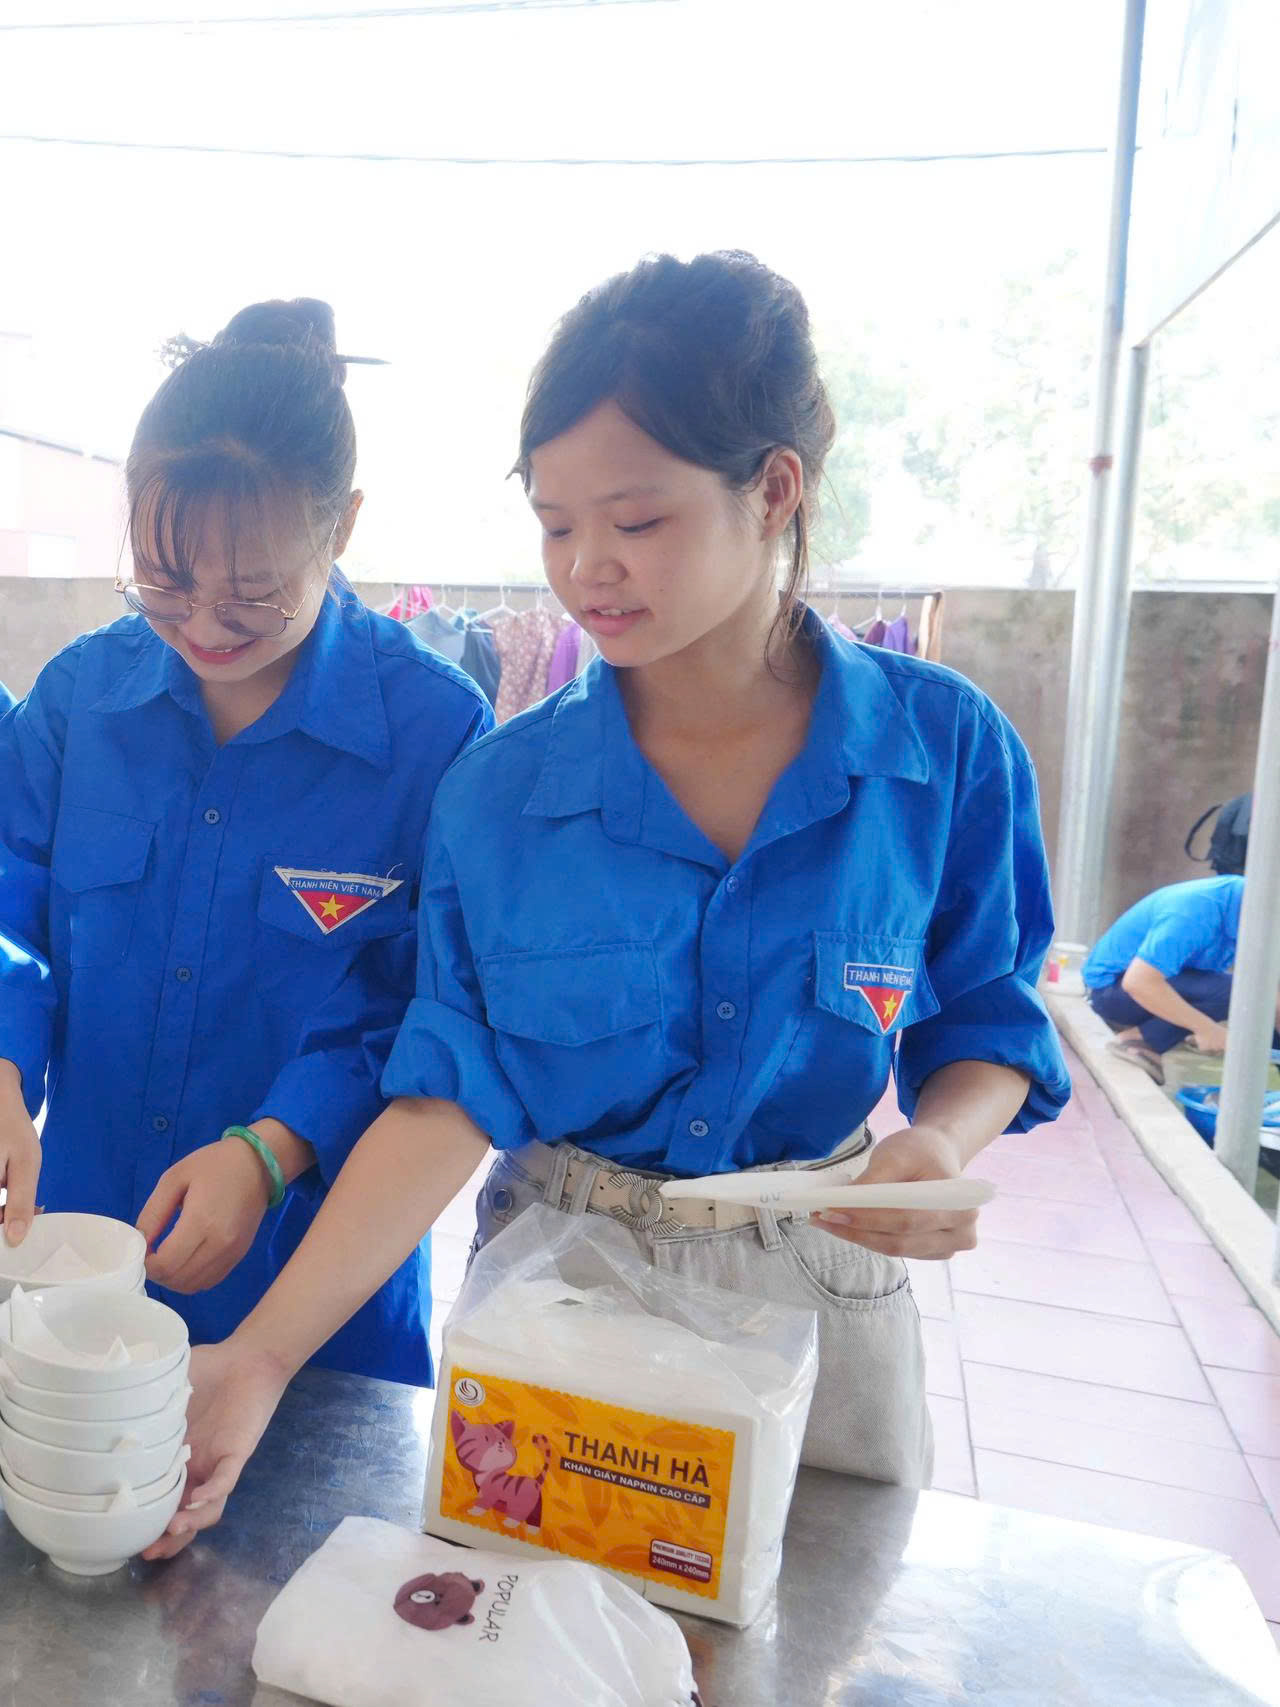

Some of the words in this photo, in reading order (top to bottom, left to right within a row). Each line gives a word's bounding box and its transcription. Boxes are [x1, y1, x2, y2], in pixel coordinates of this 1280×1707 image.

[291, 879, 319, 889] THANH
[361, 886, 382, 897] NAM
[847, 969, 880, 983] THANH
[564, 1431, 660, 1475] THANH
[670, 1457, 709, 1488] HÀ
[619, 1476, 658, 1494] NAPKIN
[660, 1486, 682, 1499] CAO
[652, 1555, 678, 1570] 240mm
[683, 1564, 709, 1579] 240mm
[479, 1575, 518, 1642] POPULAR
